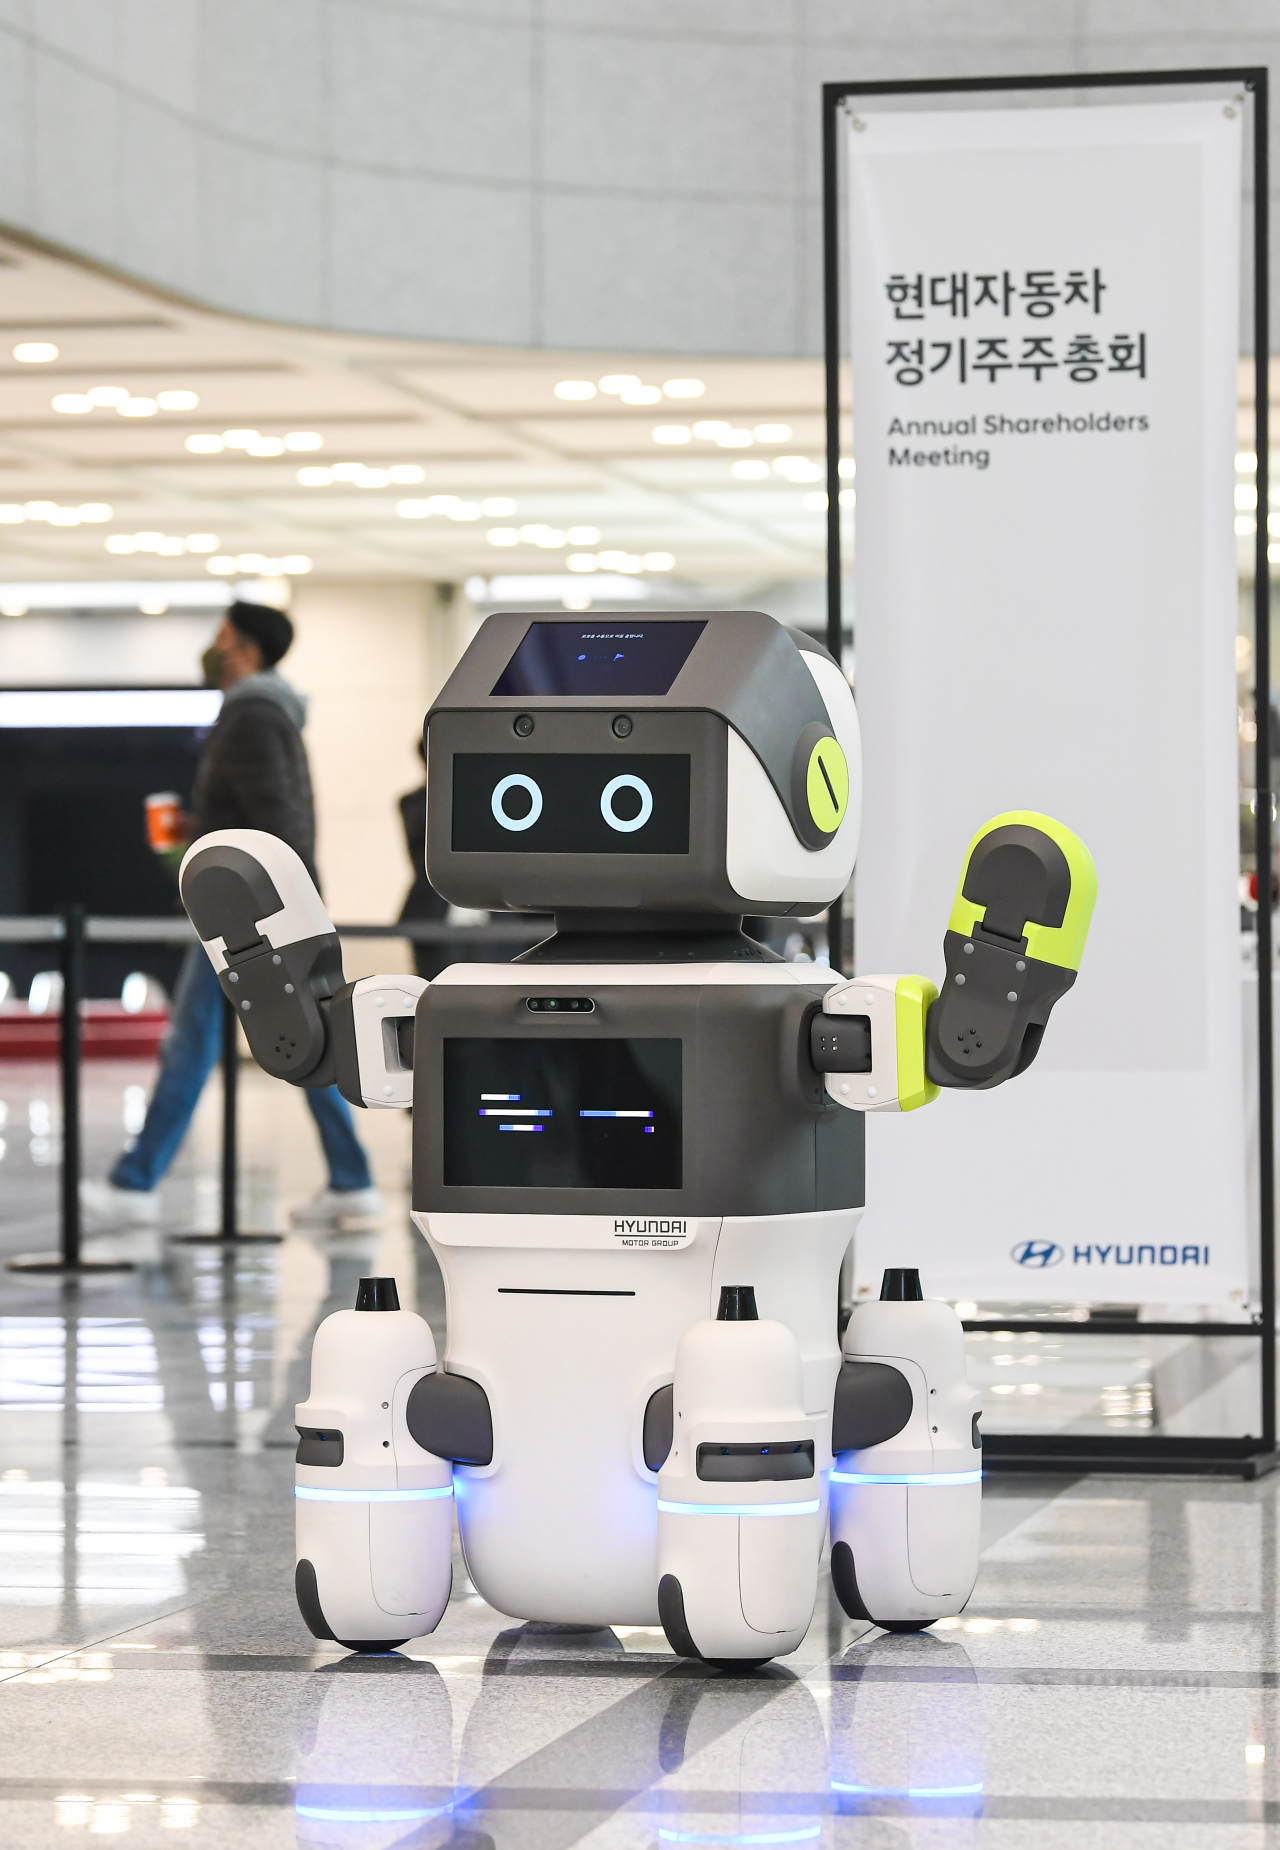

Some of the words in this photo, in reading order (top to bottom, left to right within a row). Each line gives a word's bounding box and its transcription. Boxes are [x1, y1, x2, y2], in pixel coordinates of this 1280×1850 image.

[885, 267, 1107, 321] 현대자동차
[886, 332, 1147, 387] 정기주주총회
[887, 415, 977, 436] Annual
[983, 412, 1150, 435] Shareholders
[888, 446, 991, 470] Meeting
[614, 1219, 687, 1234] HYUNDAI
[621, 1239, 650, 1247] MOTOR
[1072, 1244, 1210, 1266] HYUNDAI
